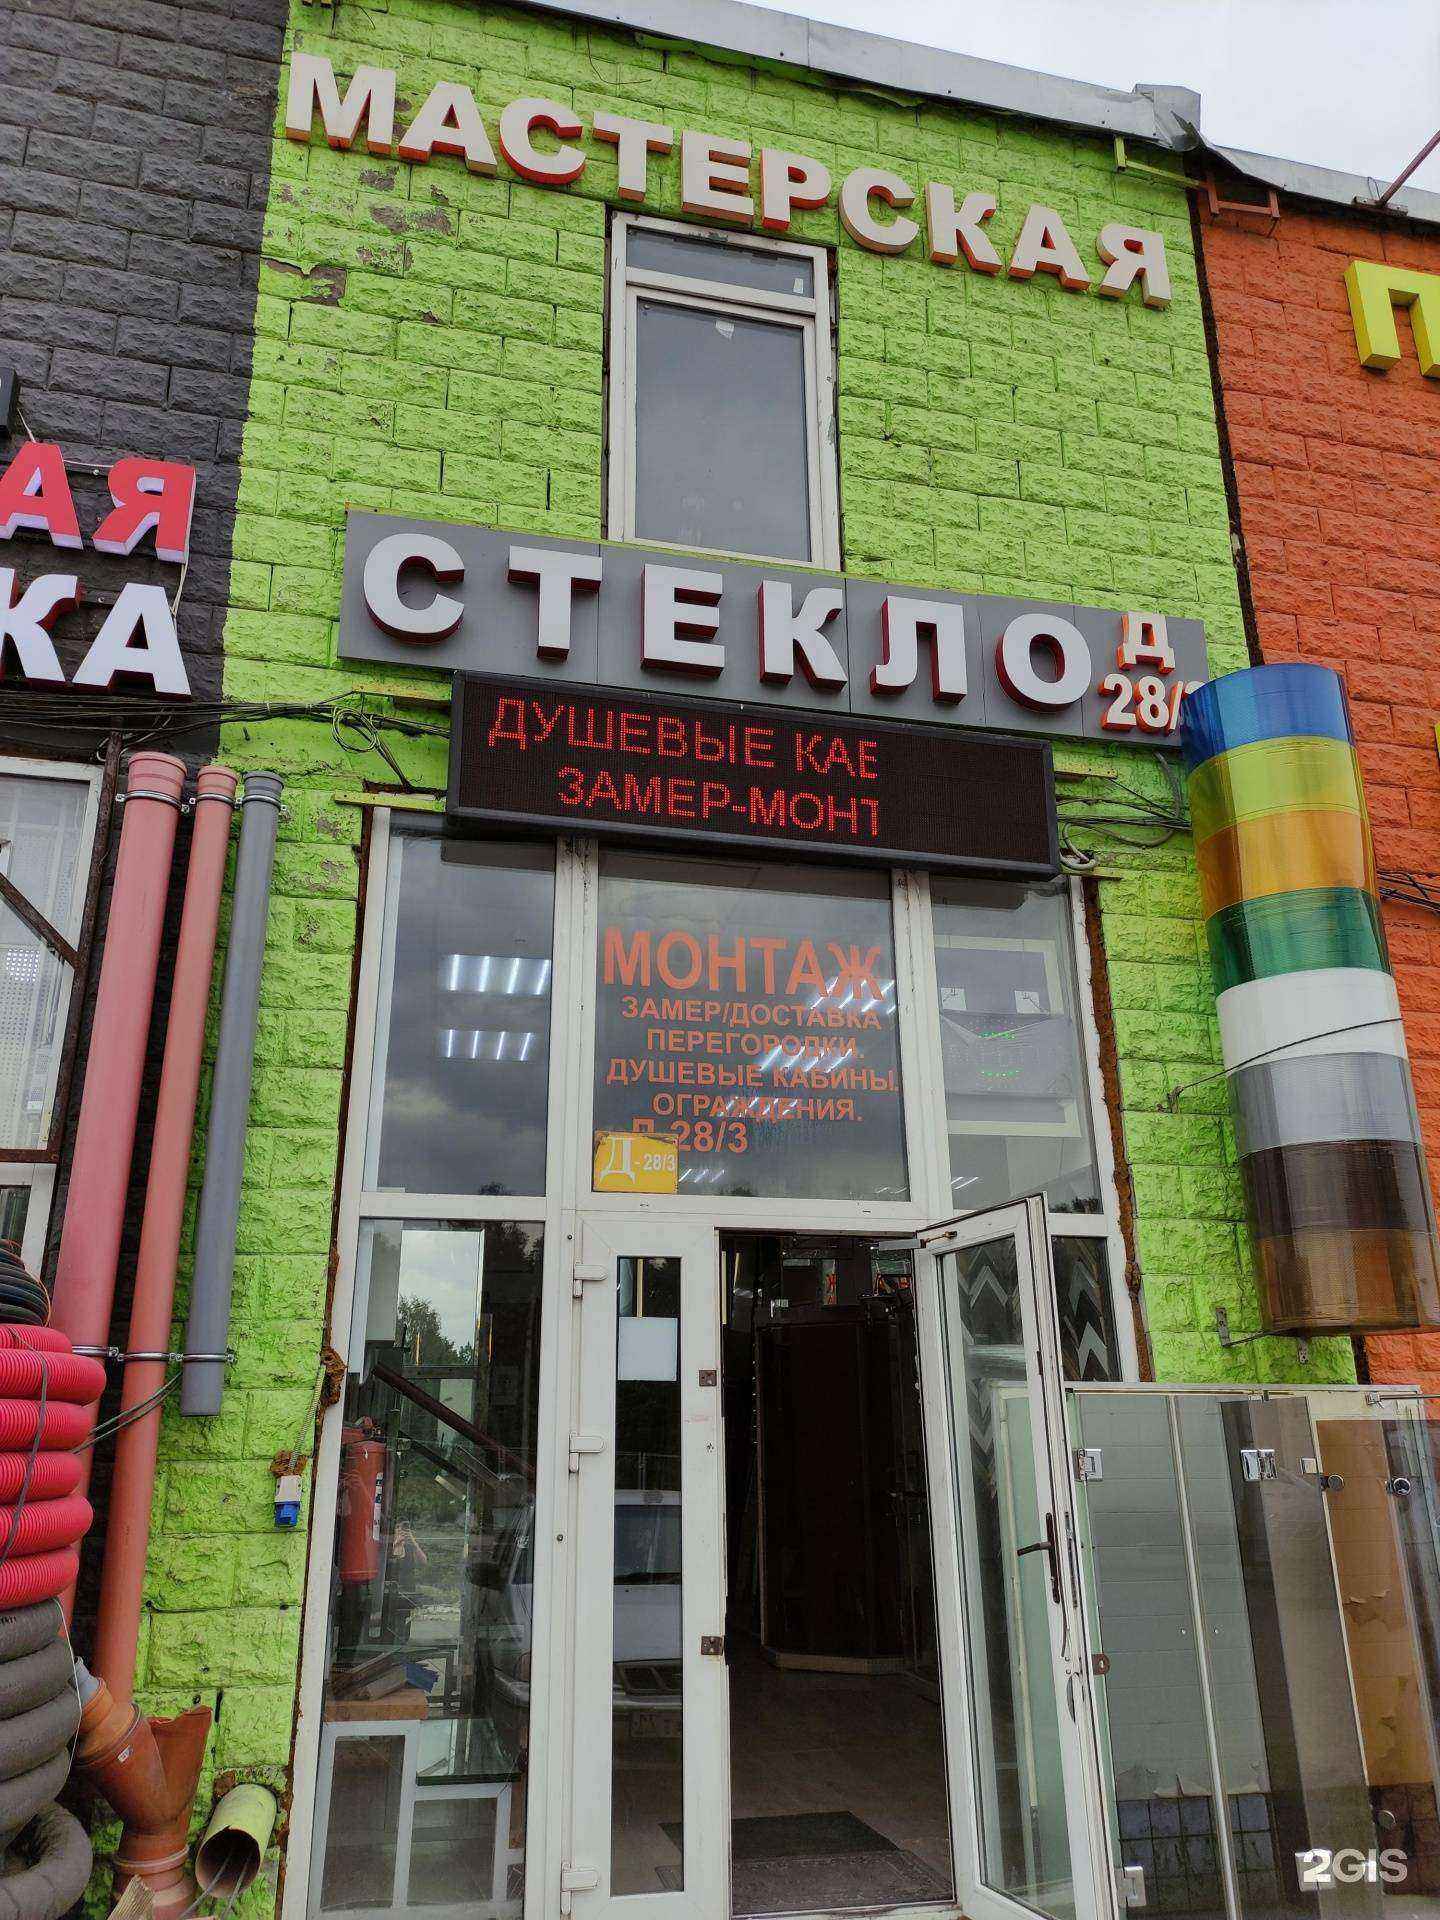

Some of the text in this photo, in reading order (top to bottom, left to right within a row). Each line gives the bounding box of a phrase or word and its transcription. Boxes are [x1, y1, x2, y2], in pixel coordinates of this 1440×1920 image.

[286, 52, 1172, 308] МАСТЕРСКАЯ
[361, 533, 1092, 712] СТЕКЛО
[1116, 611, 1176, 674] Д
[487, 696, 774, 768] ДУШЕВЫЕ
[1098, 673, 1205, 736] 28/
[558, 764, 880, 837] ЗАМЕР-МОНТ
[603, 924, 886, 1001] МОНТАЖ
[622, 995, 882, 1031] ЗАМЕР/ДОСТАВКА
[606, 1056, 765, 1087] ДУШЕВЫЕ
